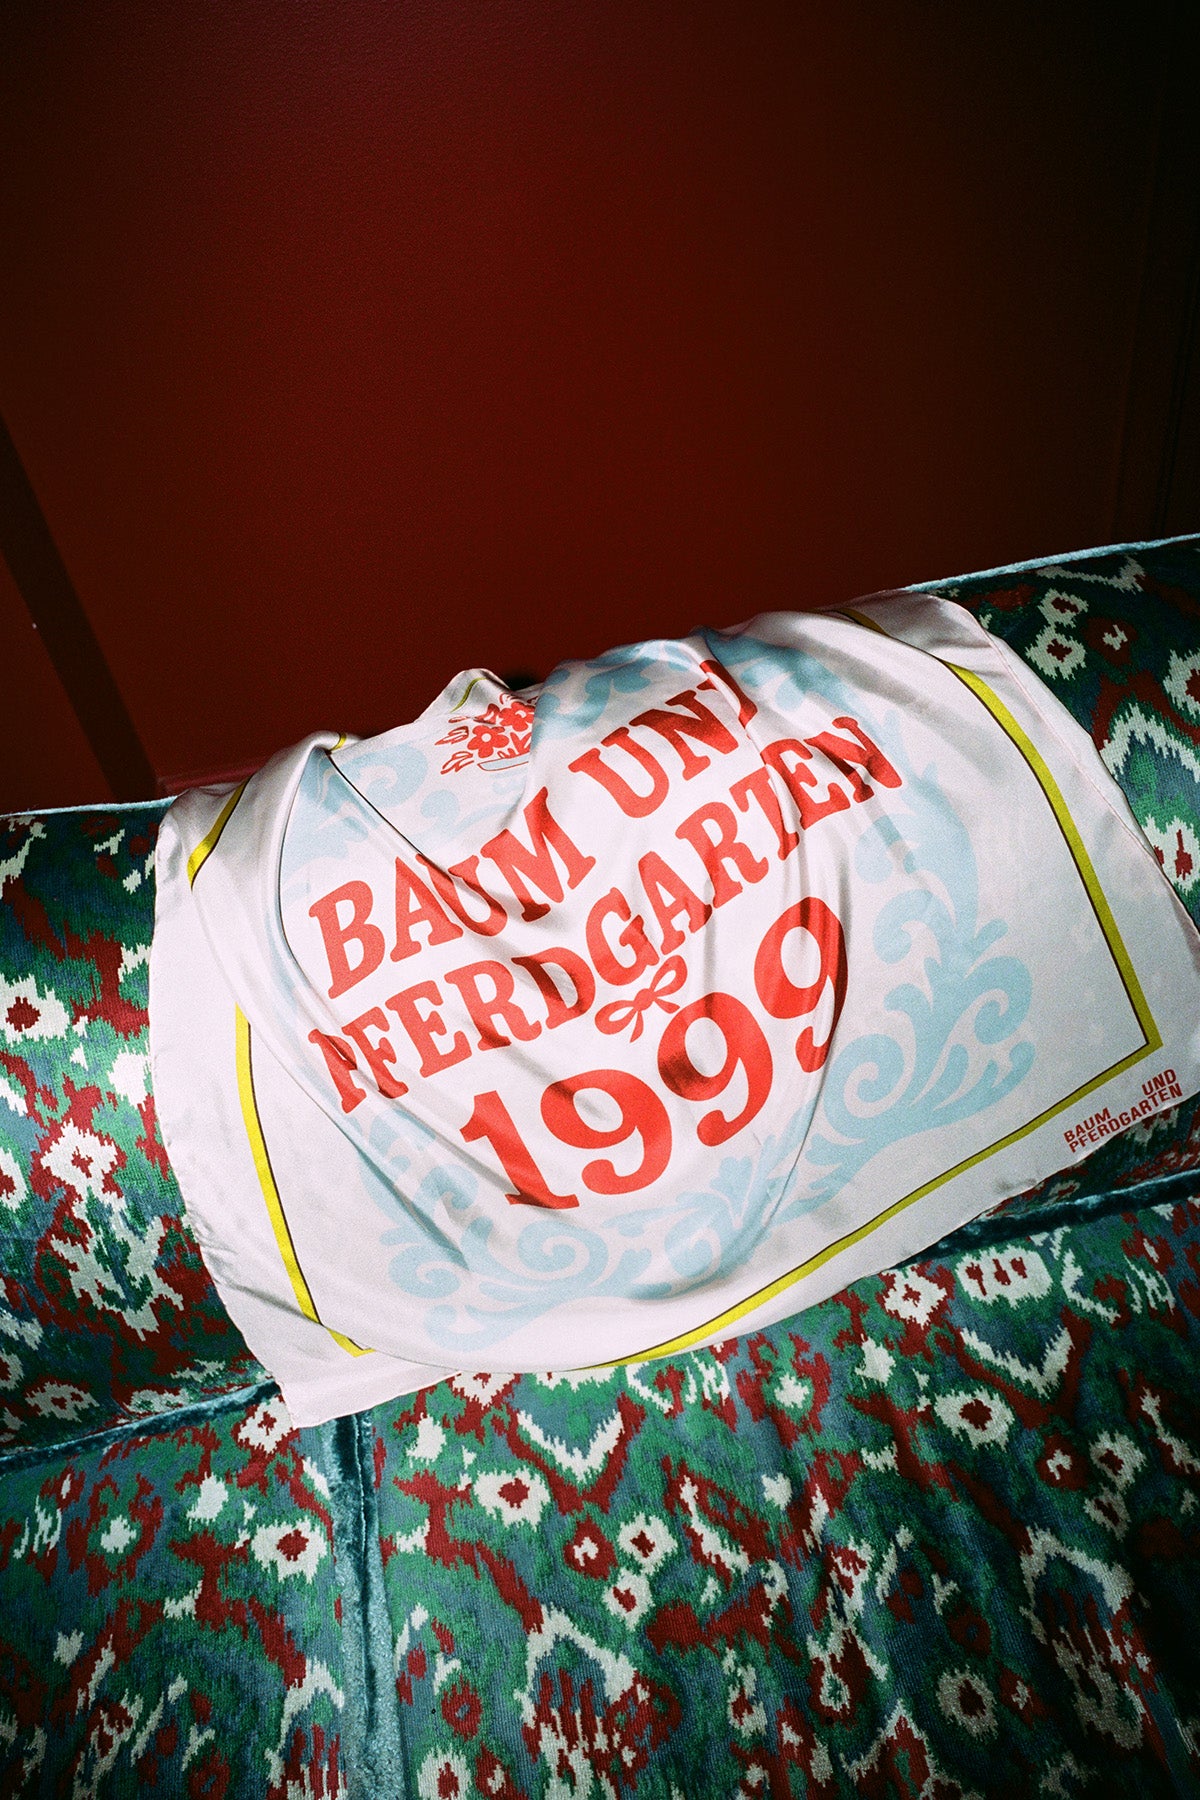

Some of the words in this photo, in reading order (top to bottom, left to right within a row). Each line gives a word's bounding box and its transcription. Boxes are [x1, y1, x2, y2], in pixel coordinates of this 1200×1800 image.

[308, 786, 597, 999] BAUM
[308, 716, 903, 1114] PFERDGARTEN
[459, 896, 849, 1209] 1999
[1063, 1107, 1111, 1144] BAUM
[1141, 1068, 1177, 1096] UND
[1068, 1083, 1183, 1153] PFERDGARTEN
